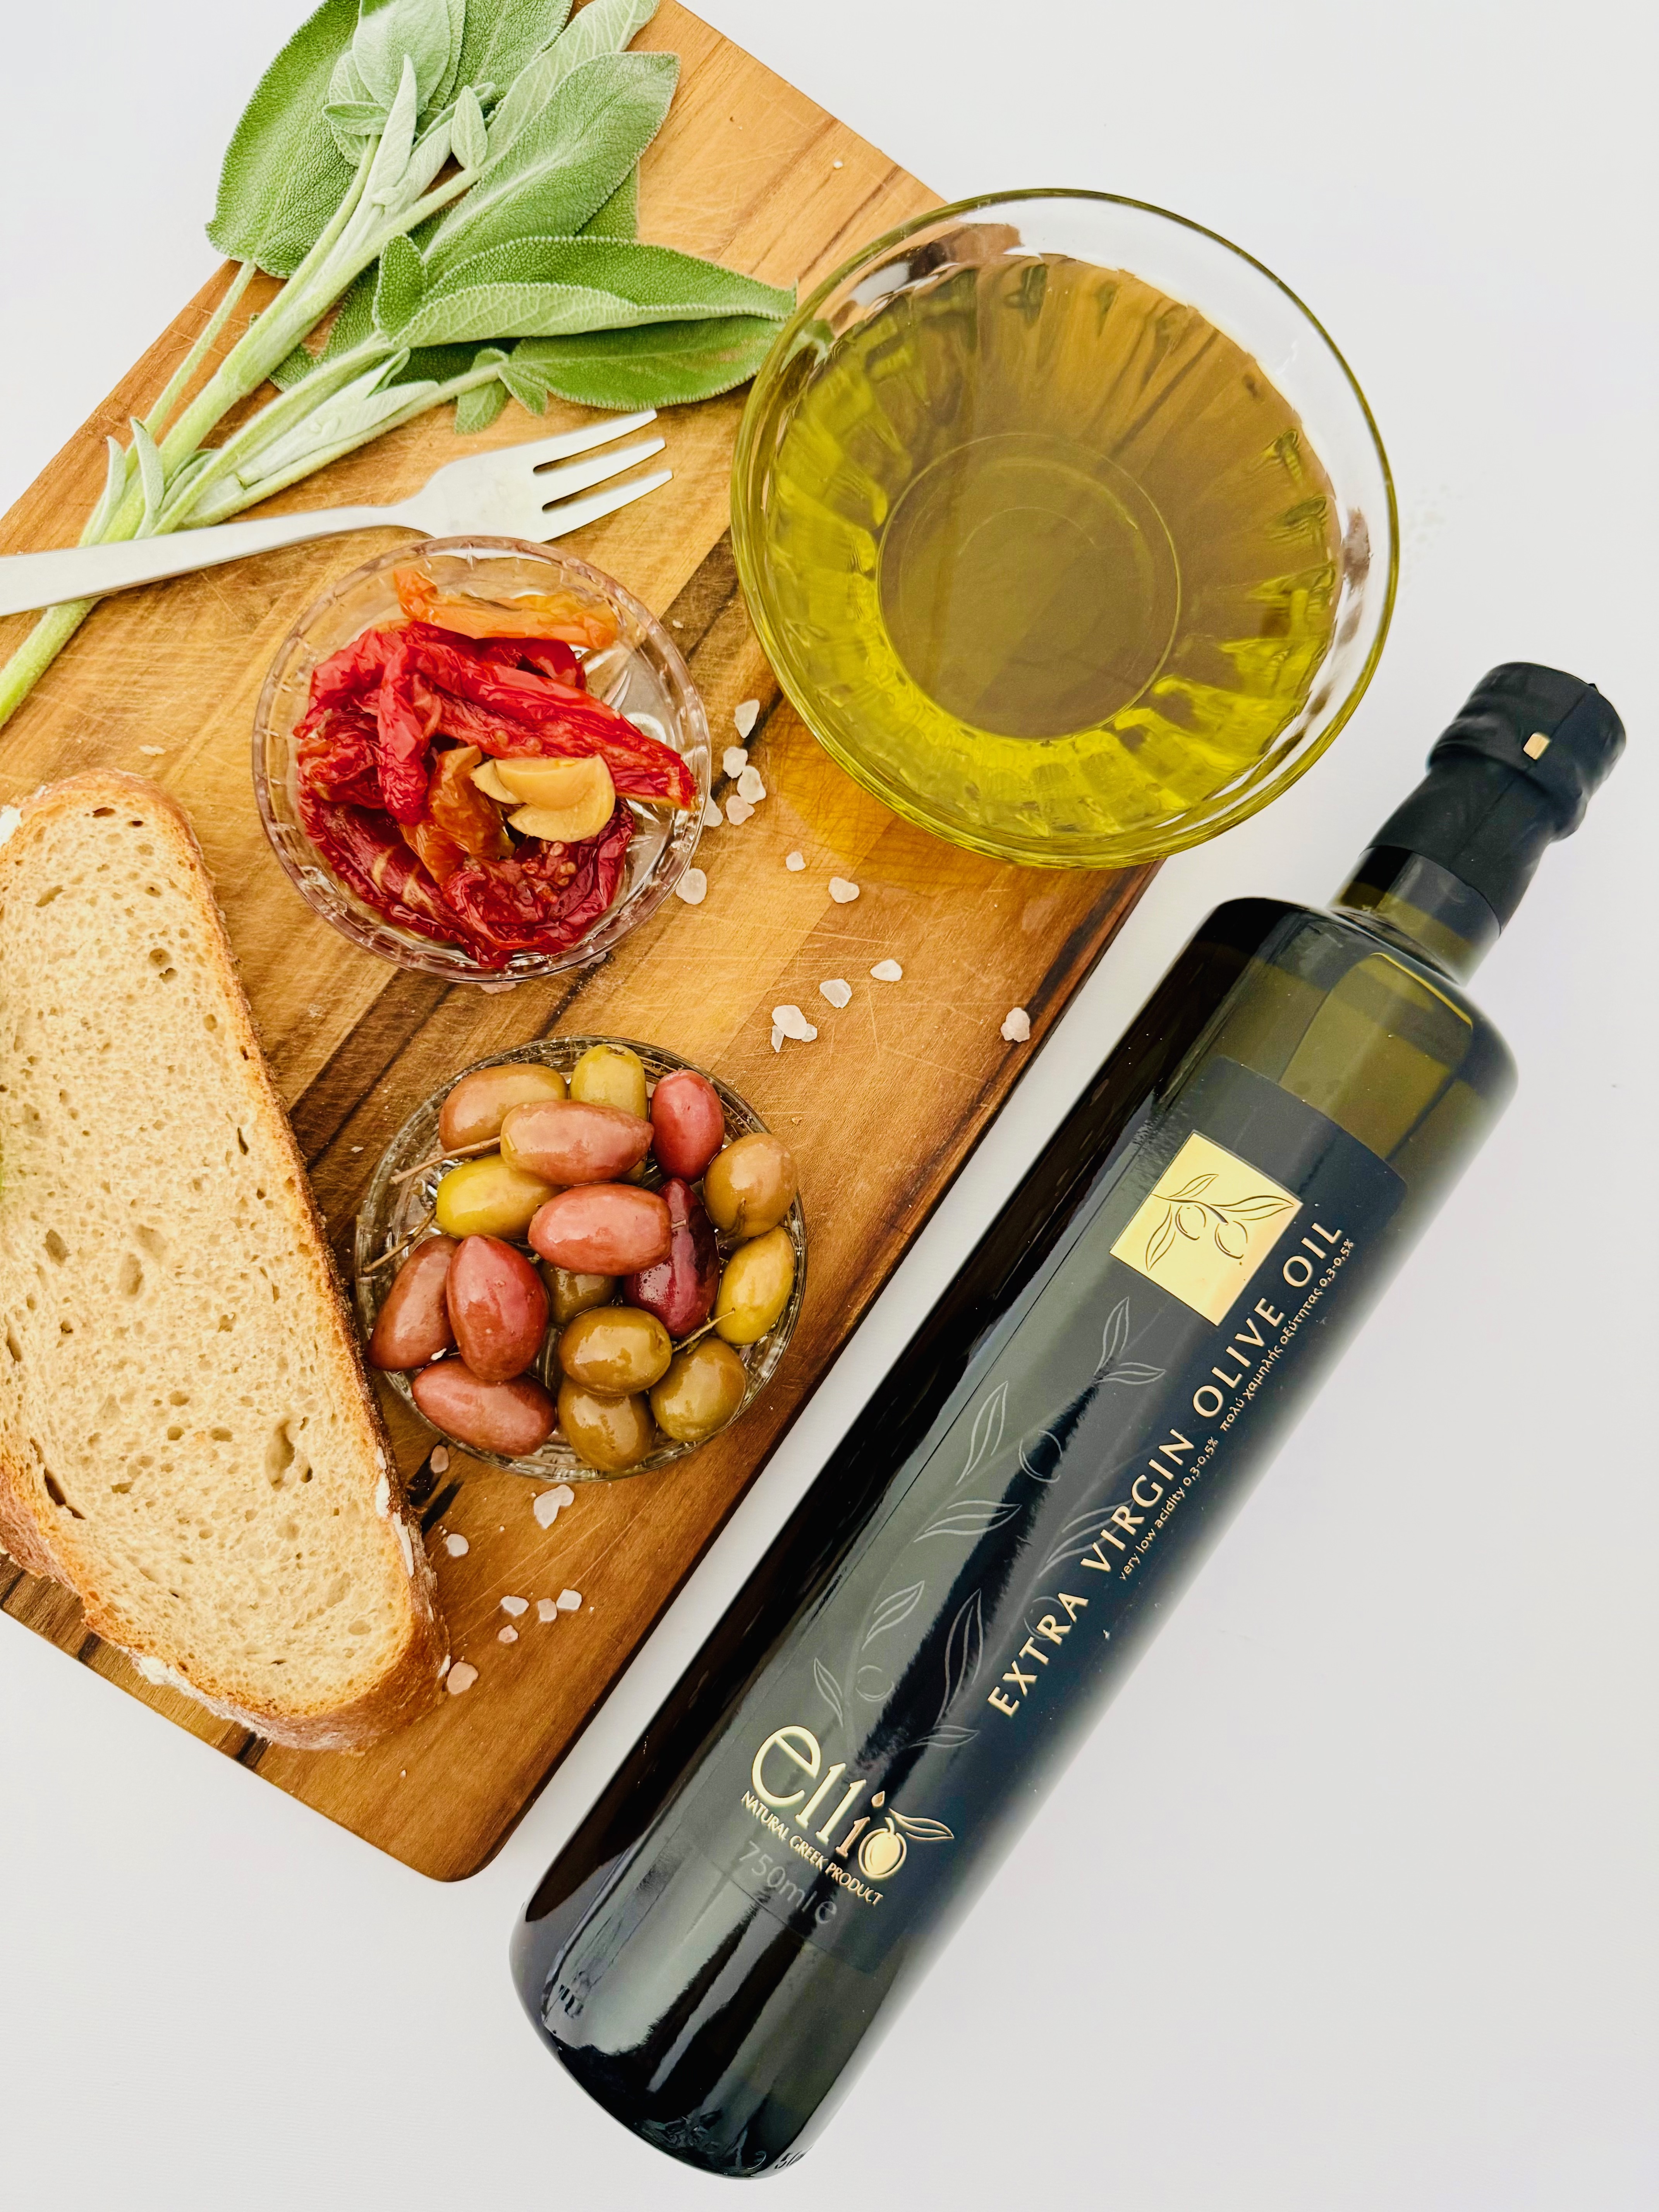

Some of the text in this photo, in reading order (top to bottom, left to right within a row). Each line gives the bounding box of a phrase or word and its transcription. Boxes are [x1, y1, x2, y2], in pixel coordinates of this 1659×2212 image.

[1220, 1239, 1353, 1431] πολύ χαμηλής οξύτητας 0,3-0,5%
[988, 1223, 1342, 1717] EXTRA VIRGIN OLIVE OIL
[1119, 1436, 1219, 1580] very low acidity 0,3-0,5%
[741, 1791, 883, 1906] NATURAL GREEK PRODUCT
